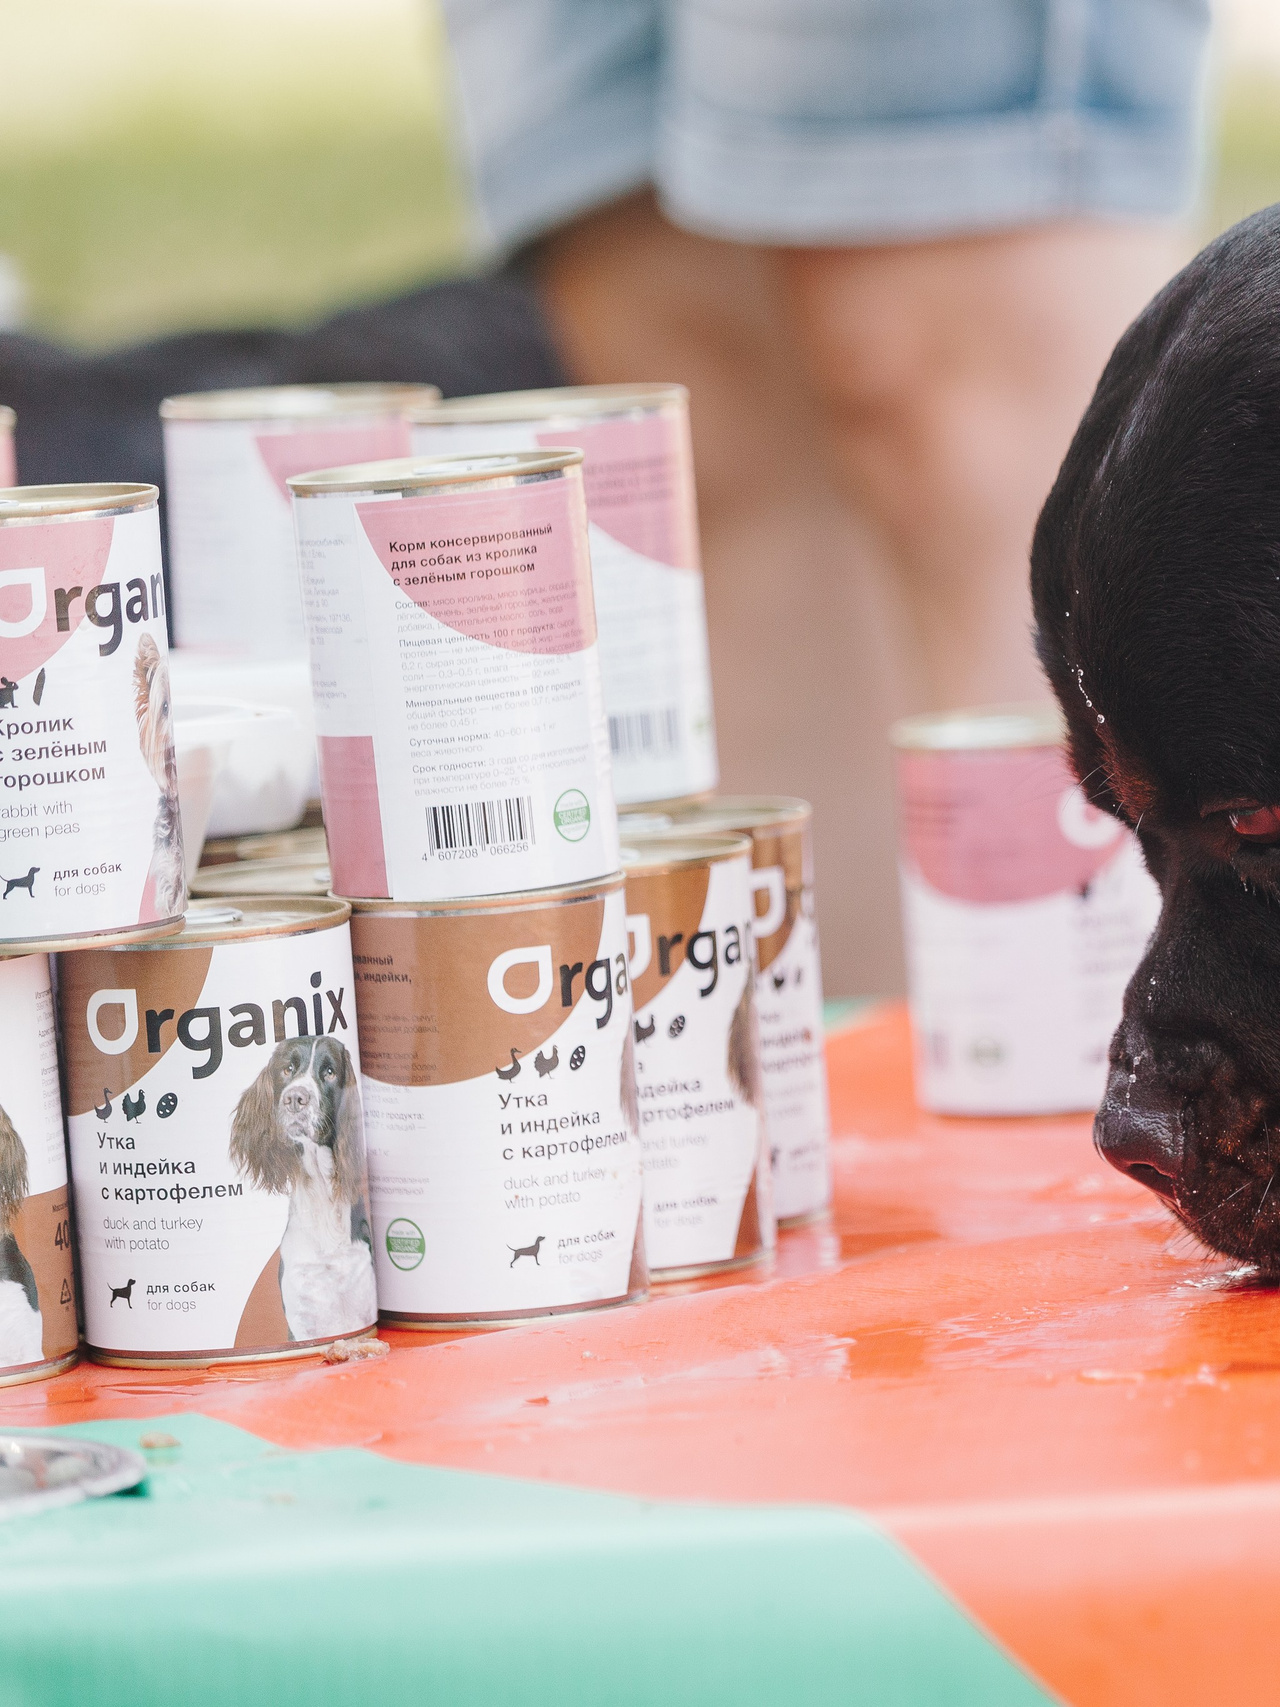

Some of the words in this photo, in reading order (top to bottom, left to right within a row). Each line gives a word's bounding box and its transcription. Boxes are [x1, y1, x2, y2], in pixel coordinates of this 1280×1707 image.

[389, 541, 426, 553] Корм
[430, 523, 553, 550] консервированный
[391, 555, 416, 571] для
[420, 552, 462, 567] собак
[466, 551, 482, 562] из
[486, 545, 538, 561] кролика
[393, 577, 401, 586] с
[404, 572, 466, 586] зелёным
[470, 562, 535, 580] горошком
[395, 600, 430, 610] Состав:
[432, 598, 456, 606] мясо
[457, 594, 495, 604] кролика,
[399, 637, 442, 648] Пищевая
[444, 634, 490, 645] ценность
[493, 629, 508, 638] 100
[517, 623, 555, 635] продукта:
[400, 650, 437, 660] протеин
[405, 696, 472, 709] Минеральные
[474, 690, 520, 702] вещества
[531, 685, 544, 694] 100
[409, 737, 455, 747] Суточная
[458, 732, 491, 743] норма:
[11, 740, 107, 761] зелёным
[410, 749, 432, 758] веса
[412, 764, 437, 774] Срок
[439, 760, 487, 772] годности:
[43, 800, 73, 815] with
[45, 822, 80, 838] peas
[421, 853, 428, 862] 4
[438, 848, 479, 861] 607208
[489, 842, 529, 856] 066256
[53, 868, 79, 881] для
[83, 863, 122, 877] собак
[54, 885, 71, 897] for
[75, 881, 106, 896] dogs
[363, 971, 412, 984] индейки,
[86, 971, 348, 1080] Organix
[498, 1093, 548, 1110] Утка
[640, 1099, 735, 1125] ртофелем
[501, 1122, 513, 1135] и
[520, 1111, 601, 1134] индейка
[97, 1132, 136, 1150] Утка
[502, 1147, 514, 1160] с
[522, 1131, 627, 1160] картофелем
[99, 1161, 108, 1174] и
[113, 1158, 196, 1178] индейка
[503, 1174, 539, 1191] duck
[543, 1170, 569, 1186] and
[572, 1165, 607, 1181] turkey
[101, 1187, 109, 1199] с
[114, 1183, 243, 1204] картофелем
[504, 1194, 534, 1210] with
[538, 1190, 581, 1209] potato
[103, 1216, 130, 1230] duck
[132, 1217, 156, 1230] and
[160, 1216, 203, 1232] turkey
[104, 1236, 126, 1249] with
[129, 1237, 170, 1252] potato
[557, 1237, 580, 1249] для
[583, 1230, 616, 1244] собак
[558, 1252, 575, 1264] for
[577, 1248, 603, 1263] dogs
[146, 1284, 169, 1295] для
[173, 1281, 216, 1293] собак
[147, 1299, 161, 1310] for
[166, 1298, 196, 1312] dogs
